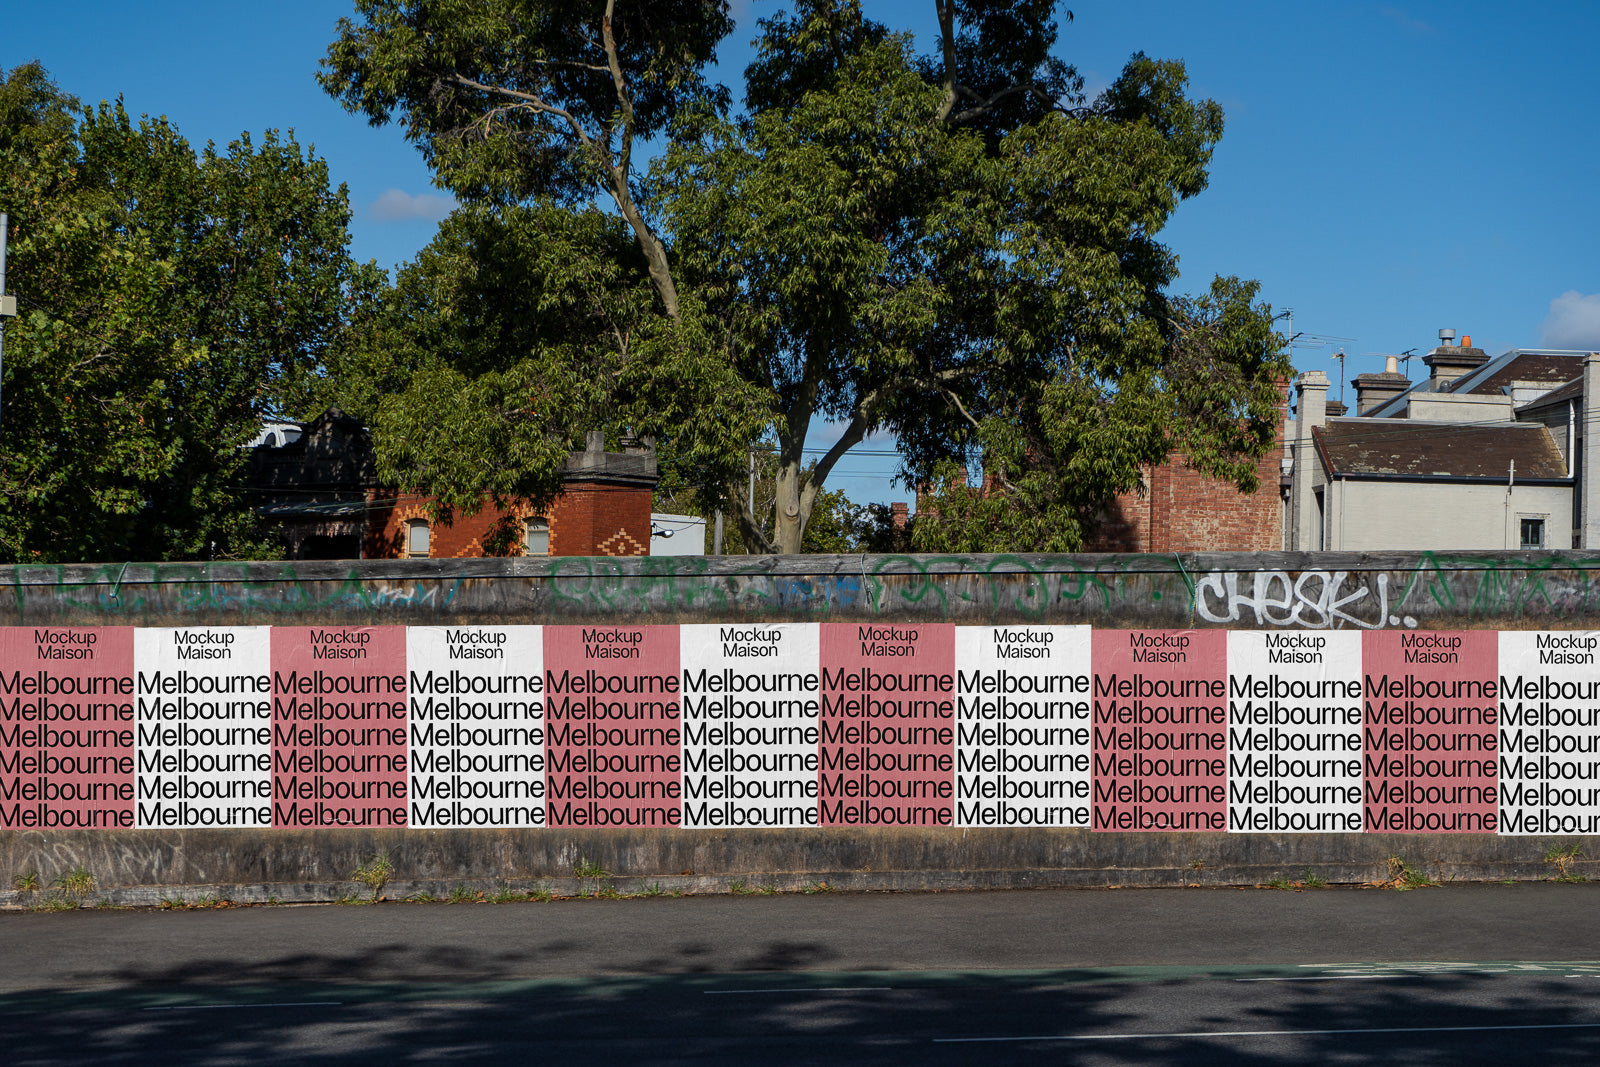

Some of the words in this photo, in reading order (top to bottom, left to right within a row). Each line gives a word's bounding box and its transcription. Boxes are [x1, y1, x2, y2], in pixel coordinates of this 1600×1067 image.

[35, 629, 97, 647] Mockup
[175, 630, 235, 648] Mockup
[311, 629, 371, 647] Mockup
[447, 629, 507, 647] Mockup
[583, 628, 643, 646] Mockup
[721, 627, 782, 645] Mockup
[859, 626, 919, 644] Mockup
[994, 628, 1054, 646] Mockup
[1131, 632, 1190, 650] Mockup
[1266, 633, 1326, 651] Mockup
[1402, 633, 1462, 651] Mockup
[1537, 634, 1598, 652] Mockup
[38, 645, 94, 659] Maison
[178, 646, 231, 660] Maison
[314, 645, 367, 659] Maison
[450, 645, 504, 659] Maison
[586, 645, 640, 659] Maison
[724, 643, 778, 657] Maison
[862, 643, 915, 657] Maison
[997, 645, 1050, 659] Maison
[1134, 649, 1186, 663] Maison
[1270, 649, 1323, 663] Maison
[1405, 649, 1458, 663] Maison
[1540, 651, 1594, 665] Maison
[0, 671, 134, 694] Melbourne
[139, 671, 270, 694] Melbourne
[275, 671, 406, 694] Melbourne
[411, 670, 543, 694] Melbourne
[547, 670, 679, 693] Melbourne
[684, 669, 818, 692] Melbourne
[823, 668, 953, 692] Melbourne
[958, 670, 1089, 693] Melbourne
[1095, 674, 1225, 697] Melbourne
[1230, 675, 1361, 698] Melbourne
[1366, 675, 1497, 698] Melbourne
[0, 697, 134, 721] Melbourne
[139, 697, 270, 720] Melbourne
[275, 697, 406, 720] Melbourne
[411, 697, 543, 720] Melbourne
[547, 696, 679, 720] Melbourne
[684, 695, 819, 719] Melbourne
[822, 694, 953, 718] Melbourne
[958, 696, 1089, 719] Melbourne
[1095, 700, 1225, 724] Melbourne
[1230, 701, 1361, 724] Melbourne
[1366, 701, 1497, 724] Melbourne
[0, 724, 134, 747] Melbourne
[139, 723, 270, 746] Melbourne
[275, 723, 406, 746] Melbourne
[411, 723, 543, 746] Melbourne
[548, 723, 680, 746] Melbourne
[684, 722, 819, 745] Melbourne
[822, 720, 953, 745] Melbourne
[958, 722, 1089, 746] Melbourne
[1095, 727, 1225, 750] Melbourne
[1230, 728, 1361, 751] Melbourne
[1366, 728, 1497, 751] Melbourne
[0, 751, 134, 774] Melbourne
[139, 749, 270, 773] Melbourne
[275, 749, 406, 773] Melbourne
[411, 749, 543, 772] Melbourne
[548, 749, 680, 772] Melbourne
[684, 748, 818, 772] Melbourne
[822, 747, 952, 771] Melbourne
[958, 749, 1089, 772] Melbourne
[1095, 753, 1225, 776] Melbourne
[1230, 754, 1361, 777] Melbourne
[1366, 754, 1497, 777] Melbourne
[0, 777, 134, 800] Melbourne
[139, 775, 270, 799] Melbourne
[275, 776, 406, 799] Melbourne
[412, 775, 543, 799] Melbourne
[549, 775, 680, 799] Melbourne
[685, 775, 818, 799] Melbourne
[822, 773, 952, 798] Melbourne
[958, 775, 1089, 798] Melbourne
[1095, 779, 1225, 803] Melbourne
[1230, 780, 1361, 804] Melbourne
[1366, 780, 1497, 804] Melbourne
[0, 803, 134, 827] Melbourne
[139, 802, 270, 825] Melbourne
[275, 802, 406, 825] Melbourne
[412, 802, 543, 825] Melbourne
[549, 802, 680, 825] Melbourne
[685, 802, 818, 825] Melbourne
[822, 800, 952, 824] Melbourne
[958, 801, 1089, 825] Melbourne
[1095, 806, 1225, 829] Melbourne
[1230, 807, 1361, 830] Melbourne
[1366, 807, 1497, 830] Melbourne
